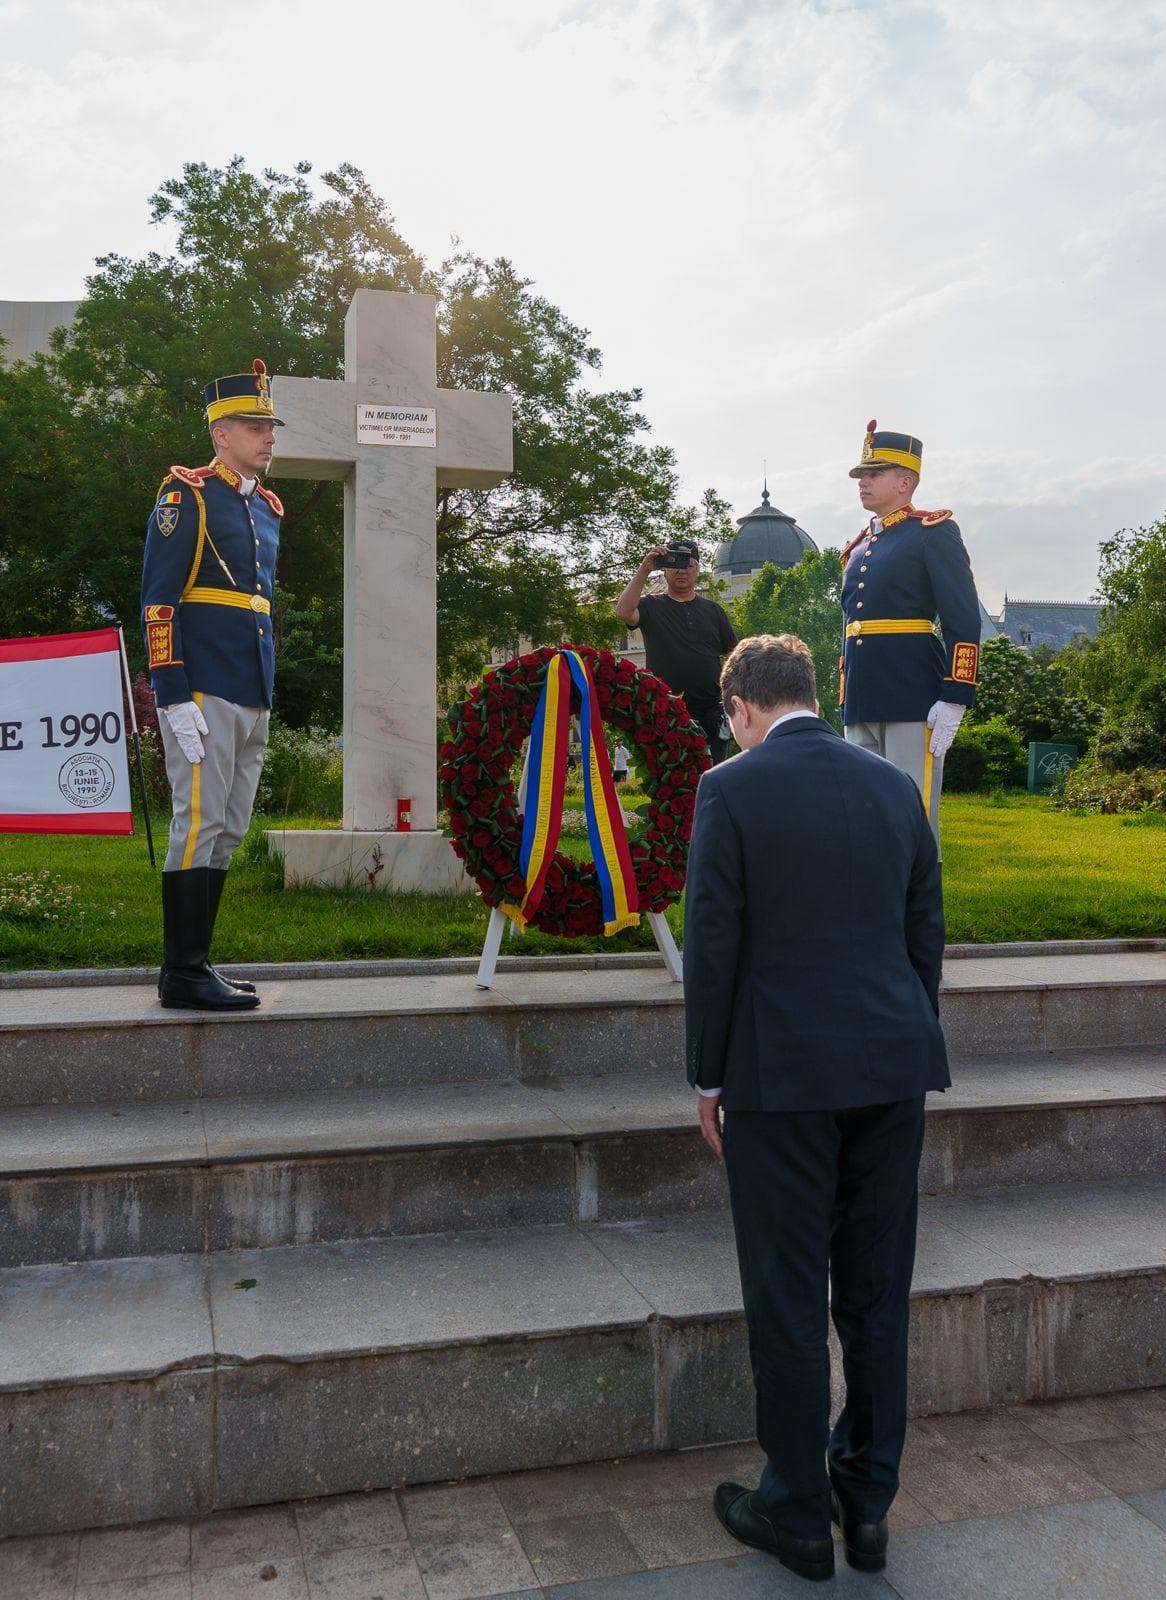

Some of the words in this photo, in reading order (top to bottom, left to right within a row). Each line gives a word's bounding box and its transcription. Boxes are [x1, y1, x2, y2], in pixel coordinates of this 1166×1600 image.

[377, 412, 428, 422] MEMORIAM
[359, 424, 392, 432] VICTIMELOR
[394, 426, 434, 434] MINERIADELOR
[0, 722, 23, 750] E
[40, 711, 121, 748] 1990
[74, 768, 97, 776] 13-15
[74, 777, 99, 785] IUNIE
[77, 786, 97, 794] 1990
